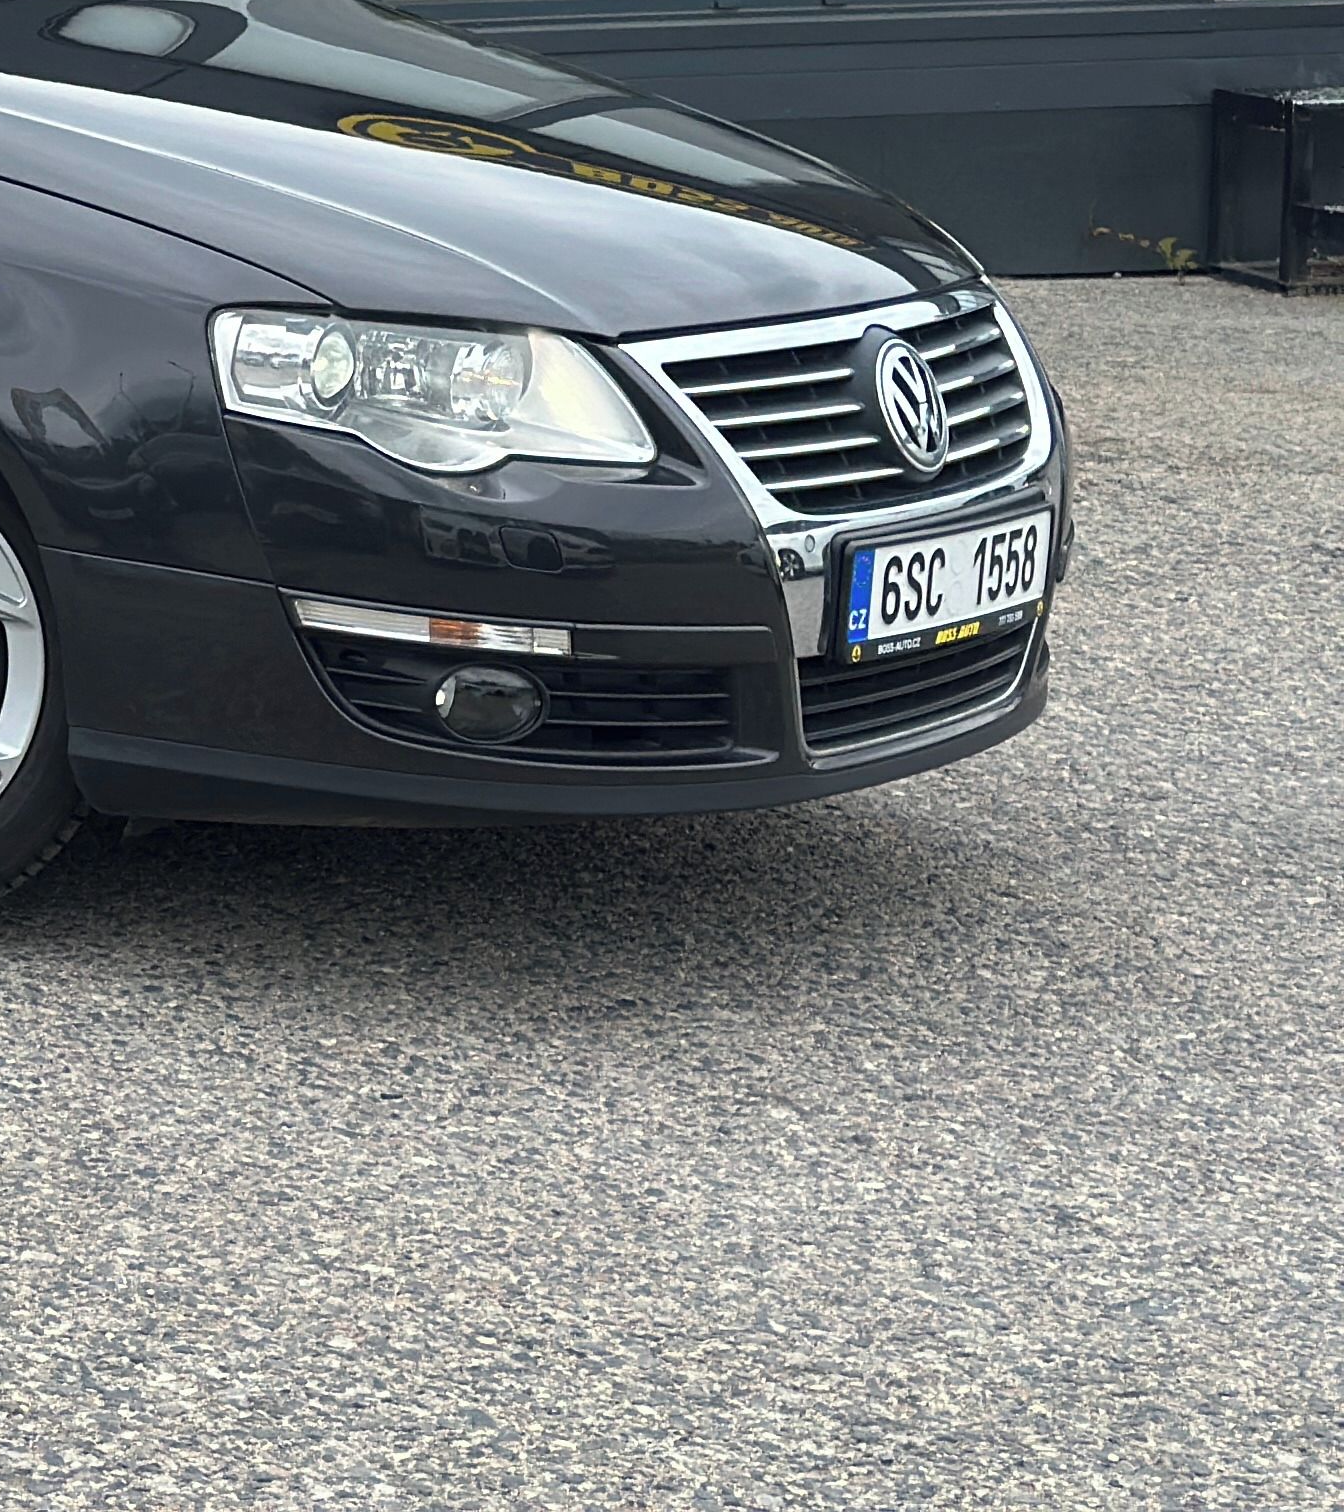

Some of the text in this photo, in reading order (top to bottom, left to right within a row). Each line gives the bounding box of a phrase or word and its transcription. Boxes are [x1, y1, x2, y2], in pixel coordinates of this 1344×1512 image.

[881, 524, 1038, 625] 6SC 1558
[849, 610, 867, 629] CZ
[877, 637, 921, 655] BOSS-AUTO.CZ
